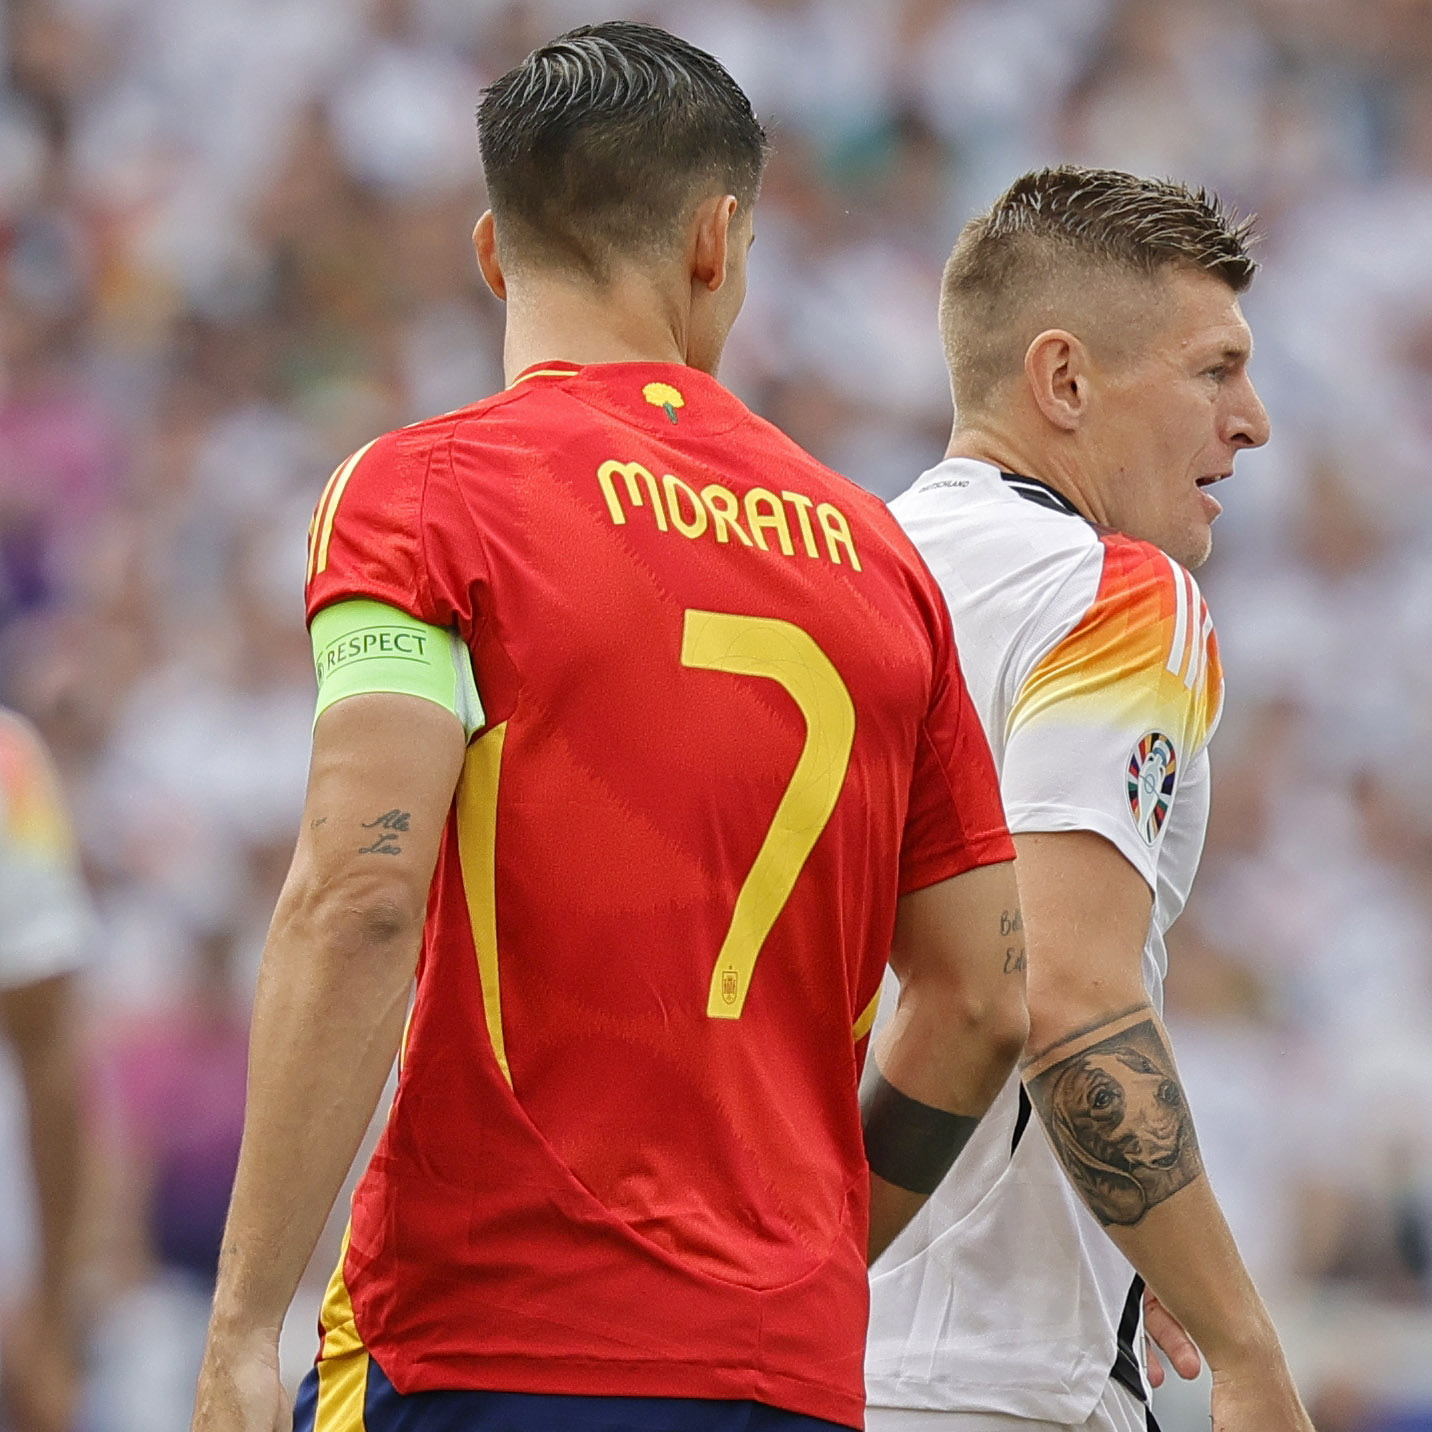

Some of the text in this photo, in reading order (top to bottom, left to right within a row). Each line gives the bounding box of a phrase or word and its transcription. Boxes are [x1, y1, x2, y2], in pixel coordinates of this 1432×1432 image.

[598, 459, 861, 571] MORATA
[327, 633, 426, 671] RESPECT
[680, 608, 856, 1019] 7
